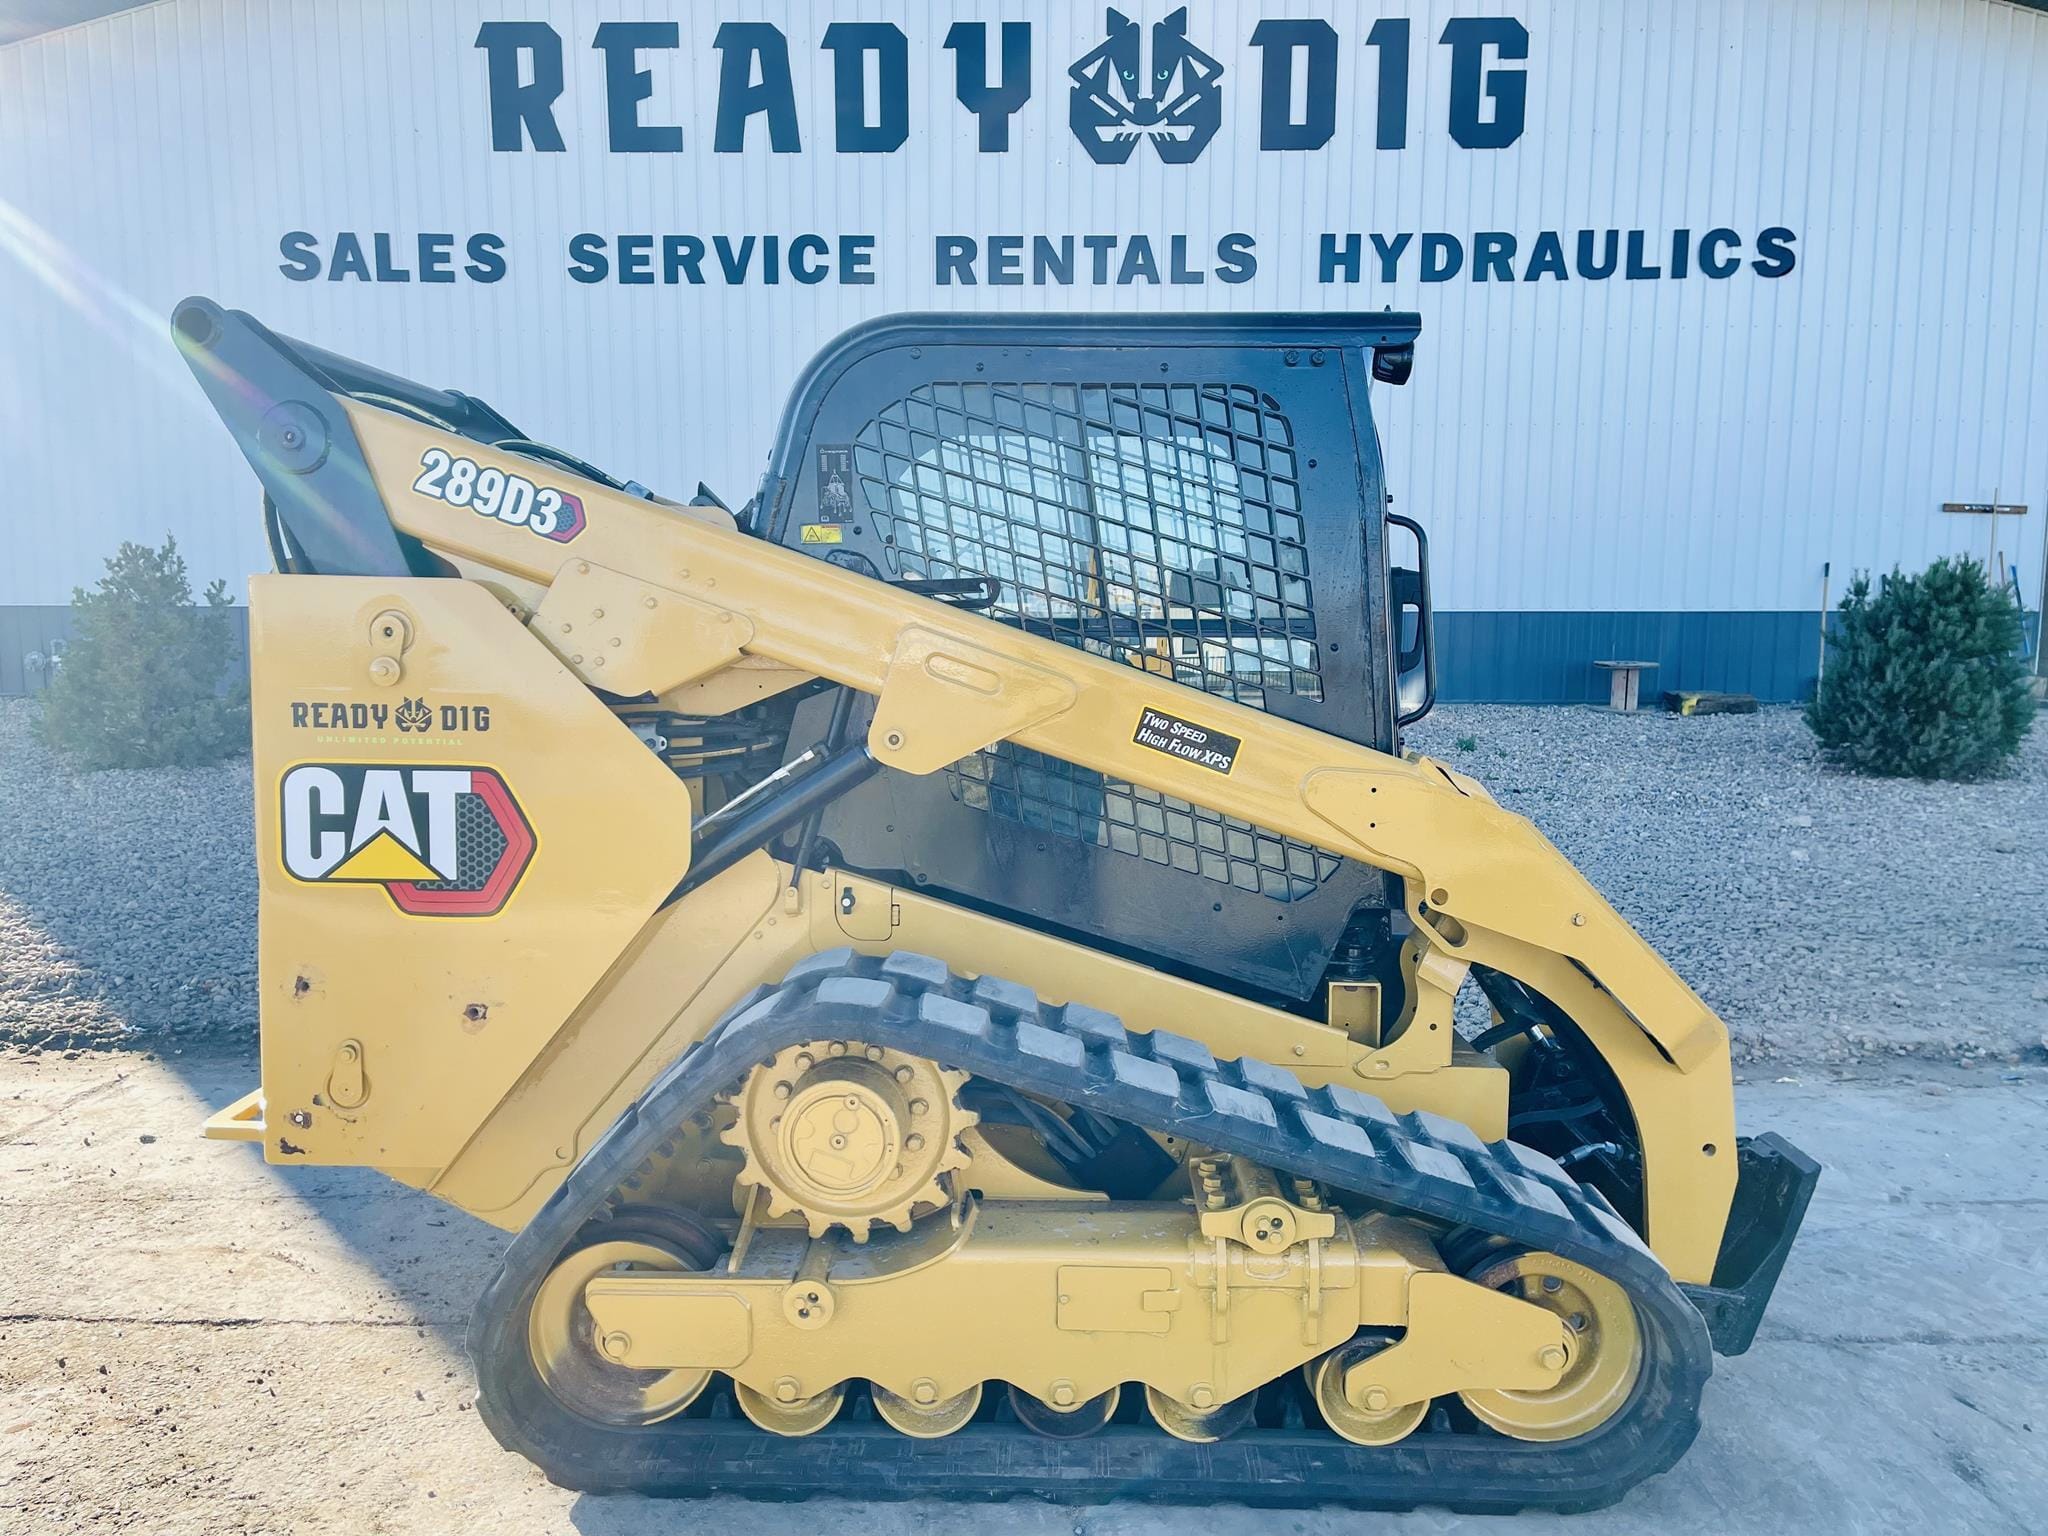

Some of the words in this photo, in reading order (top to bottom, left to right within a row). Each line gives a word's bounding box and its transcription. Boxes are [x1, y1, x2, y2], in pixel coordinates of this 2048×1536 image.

[474, 22, 1031, 153] READY
[1249, 17, 1529, 151] DIG
[280, 232, 506, 283] SALES
[568, 233, 874, 285] SERVICE
[936, 233, 1257, 285] RENTALS
[1319, 227, 1798, 283] HYDRAULICS
[413, 448, 563, 536] 289D3
[291, 702, 388, 730] READY
[440, 705, 490, 732] DIG
[316, 735, 387, 745] UNLIMITED
[392, 736, 464, 746] POTENTIAL
[1199, 749, 1232, 769] XPS
[284, 766, 472, 882] CAT
